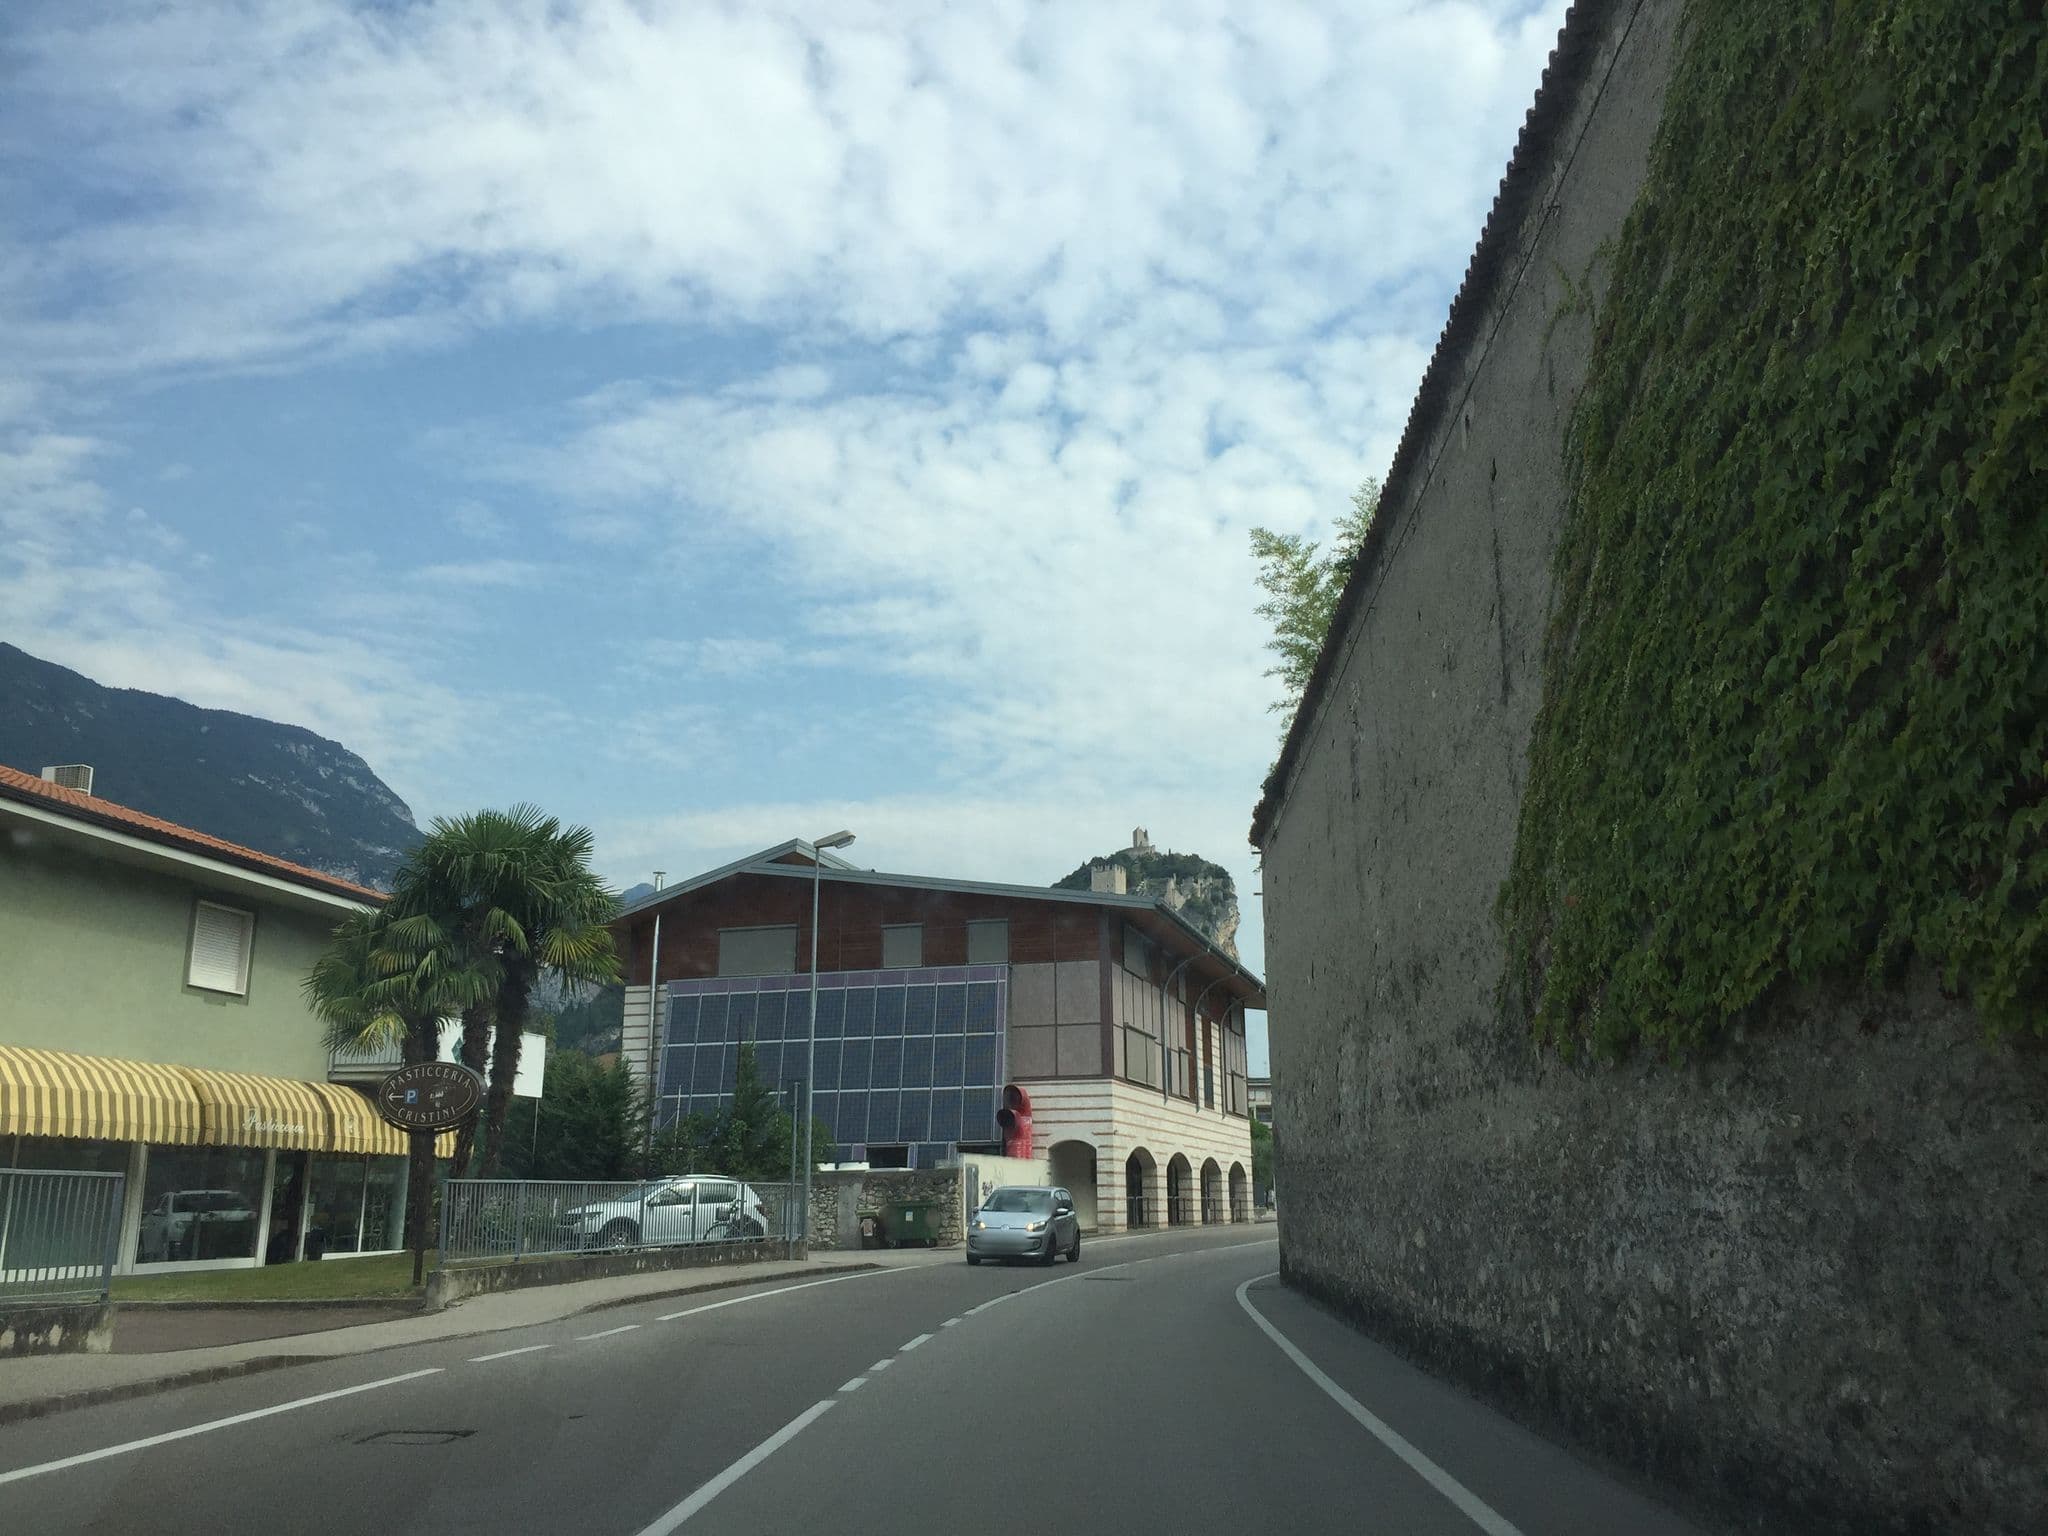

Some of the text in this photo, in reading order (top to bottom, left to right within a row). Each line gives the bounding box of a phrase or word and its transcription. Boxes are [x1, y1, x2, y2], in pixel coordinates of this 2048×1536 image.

[389, 1066, 471, 1090] PASTICCERIA
[406, 1090, 416, 1103] P
[397, 1106, 456, 1123] CRISTINI
